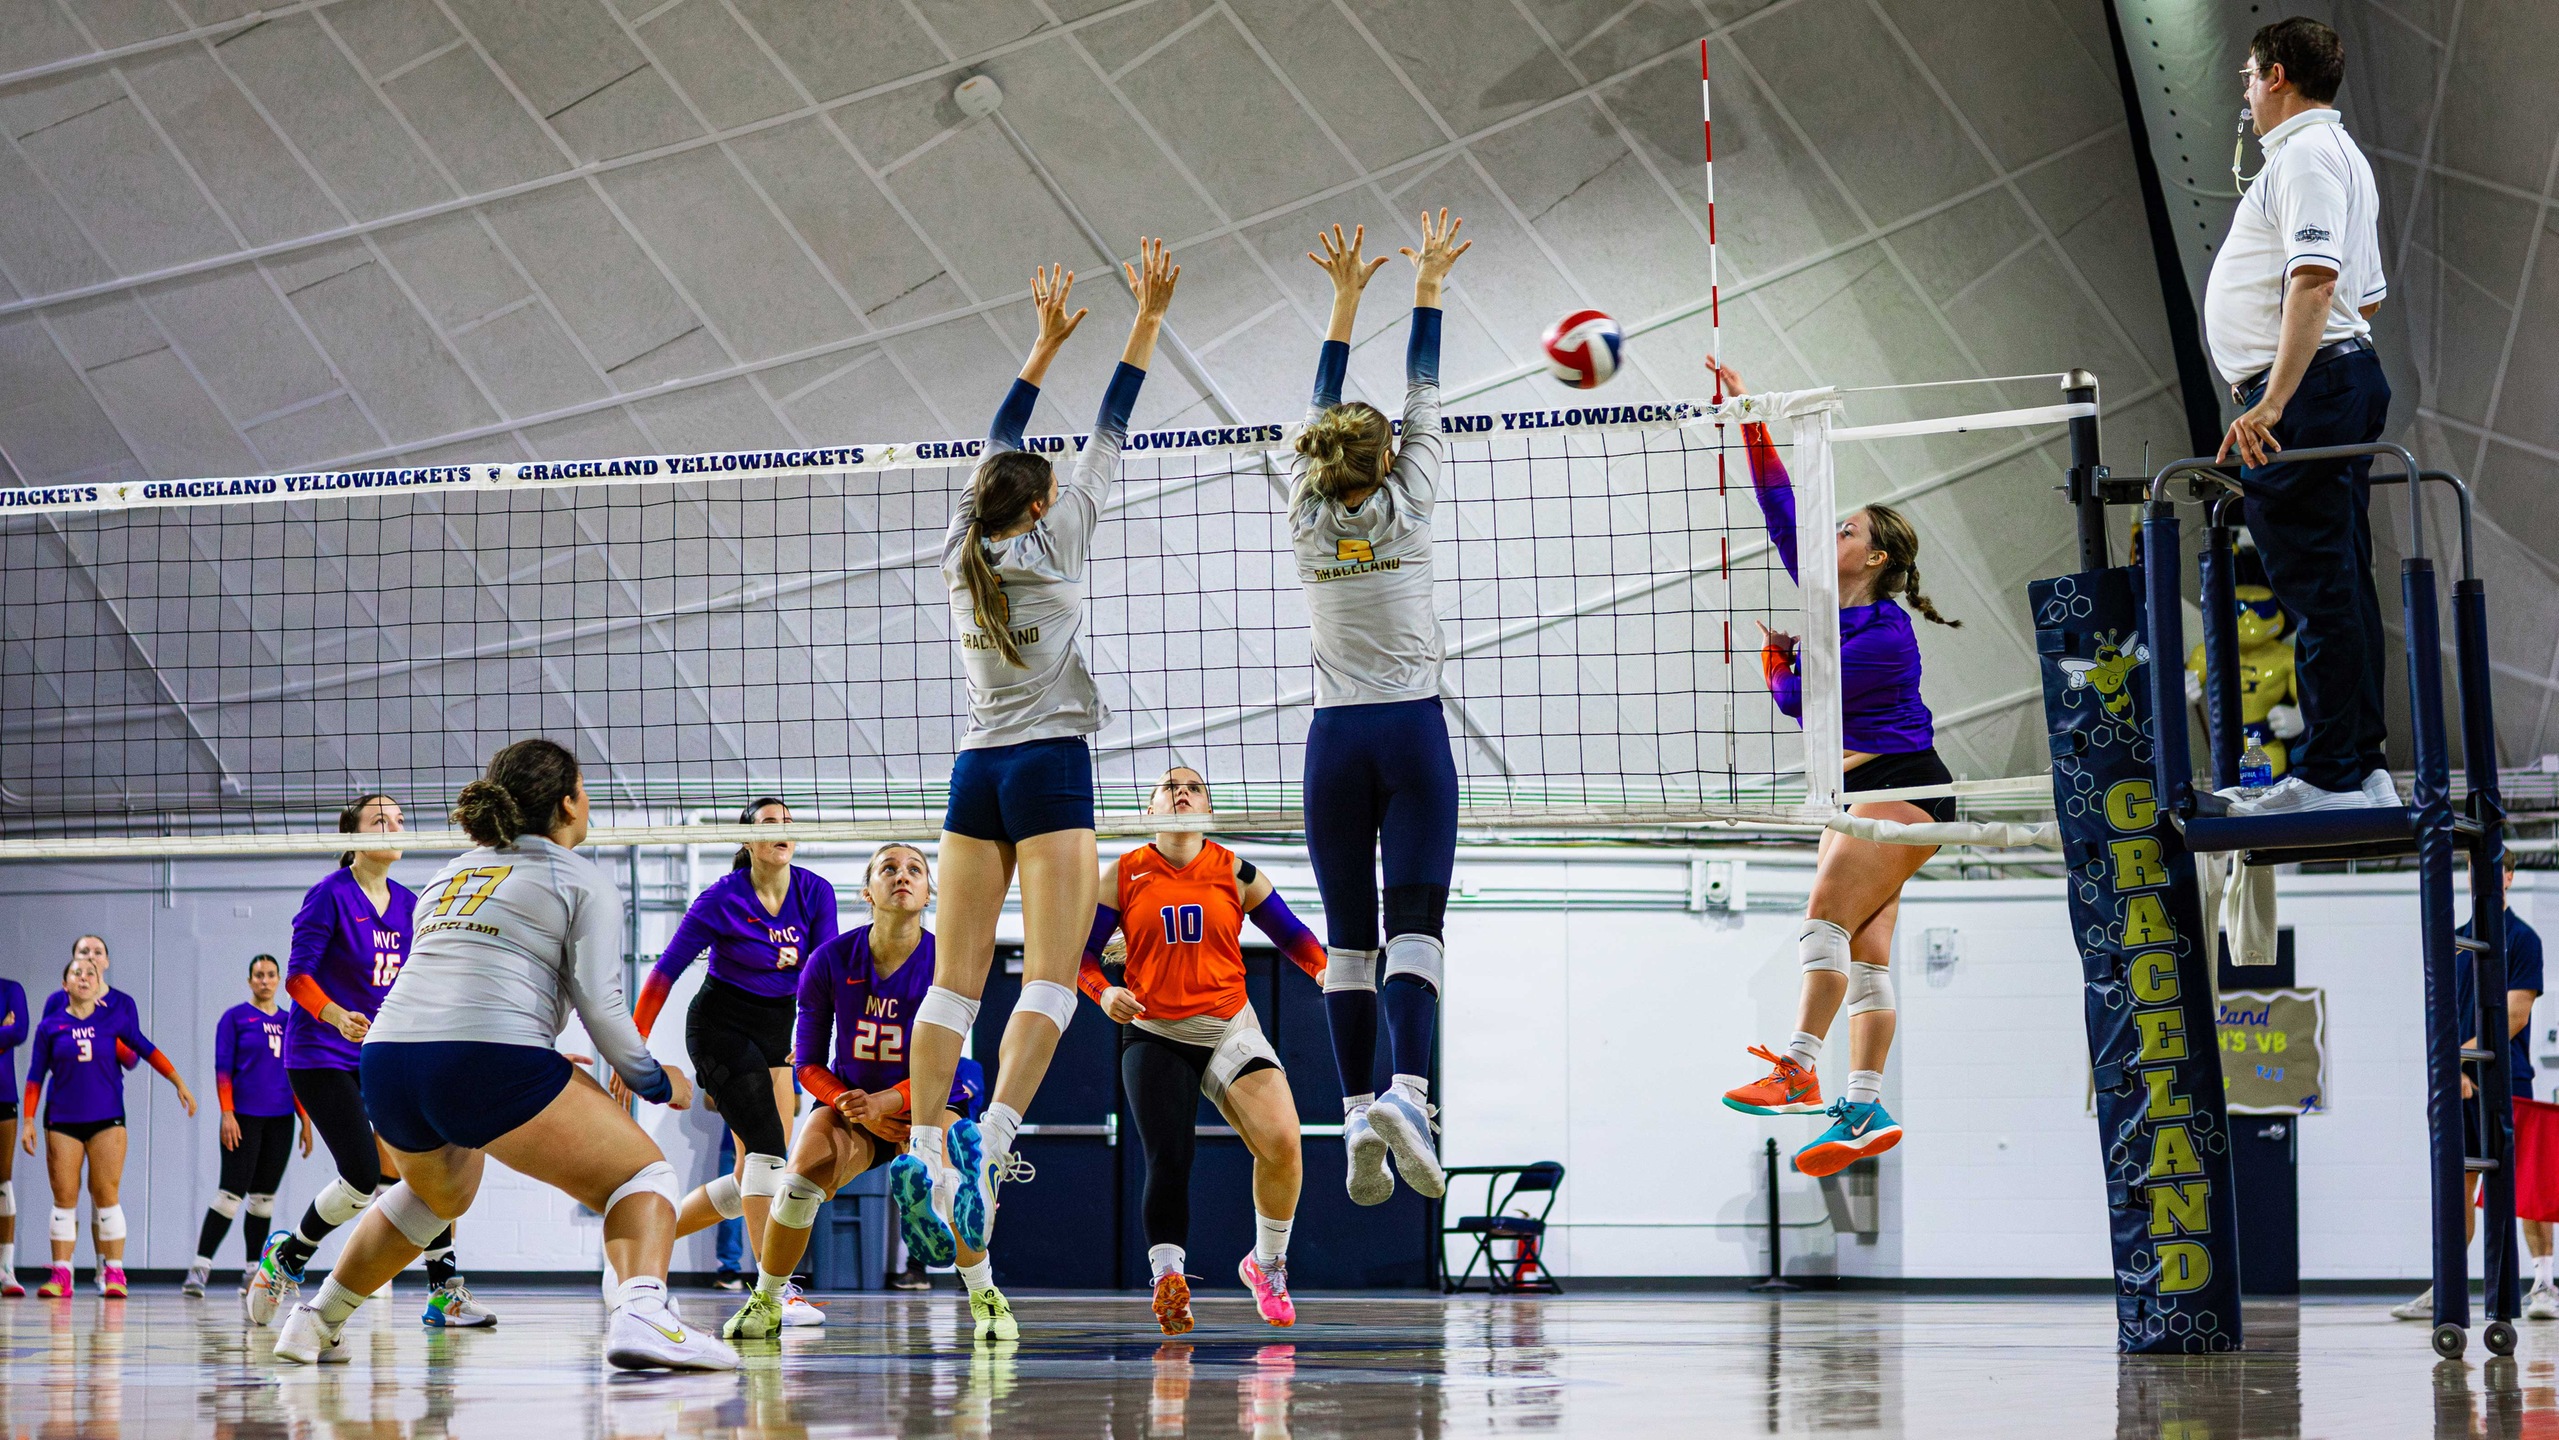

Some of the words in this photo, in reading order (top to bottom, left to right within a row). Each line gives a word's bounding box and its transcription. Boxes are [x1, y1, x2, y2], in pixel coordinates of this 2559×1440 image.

[915, 437, 1065, 459] GRACND
[1075, 424, 1283, 452] YLOWJACKETS
[517, 460, 658, 480] GRACELAND
[666, 447, 865, 474] YELLOWJACKETS
[143, 478, 277, 499] GRACELAND
[284, 466, 471, 492] YELLOWJACKETS
[962, 626, 1040, 650] RACAND
[432, 865, 514, 917] 17
[1160, 904, 1203, 944] 10
[372, 929, 400, 949] MVC
[865, 995, 898, 1018] MVC
[71, 1026, 95, 1040] MVC
[262, 1021, 283, 1035] MVC
[2103, 778, 2212, 1296] GRACELAND
[76, 1038, 92, 1062] 3
[268, 1034, 281, 1058] 4
[853, 1019, 902, 1062] 22
[2254, 1030, 2287, 1054] VB
